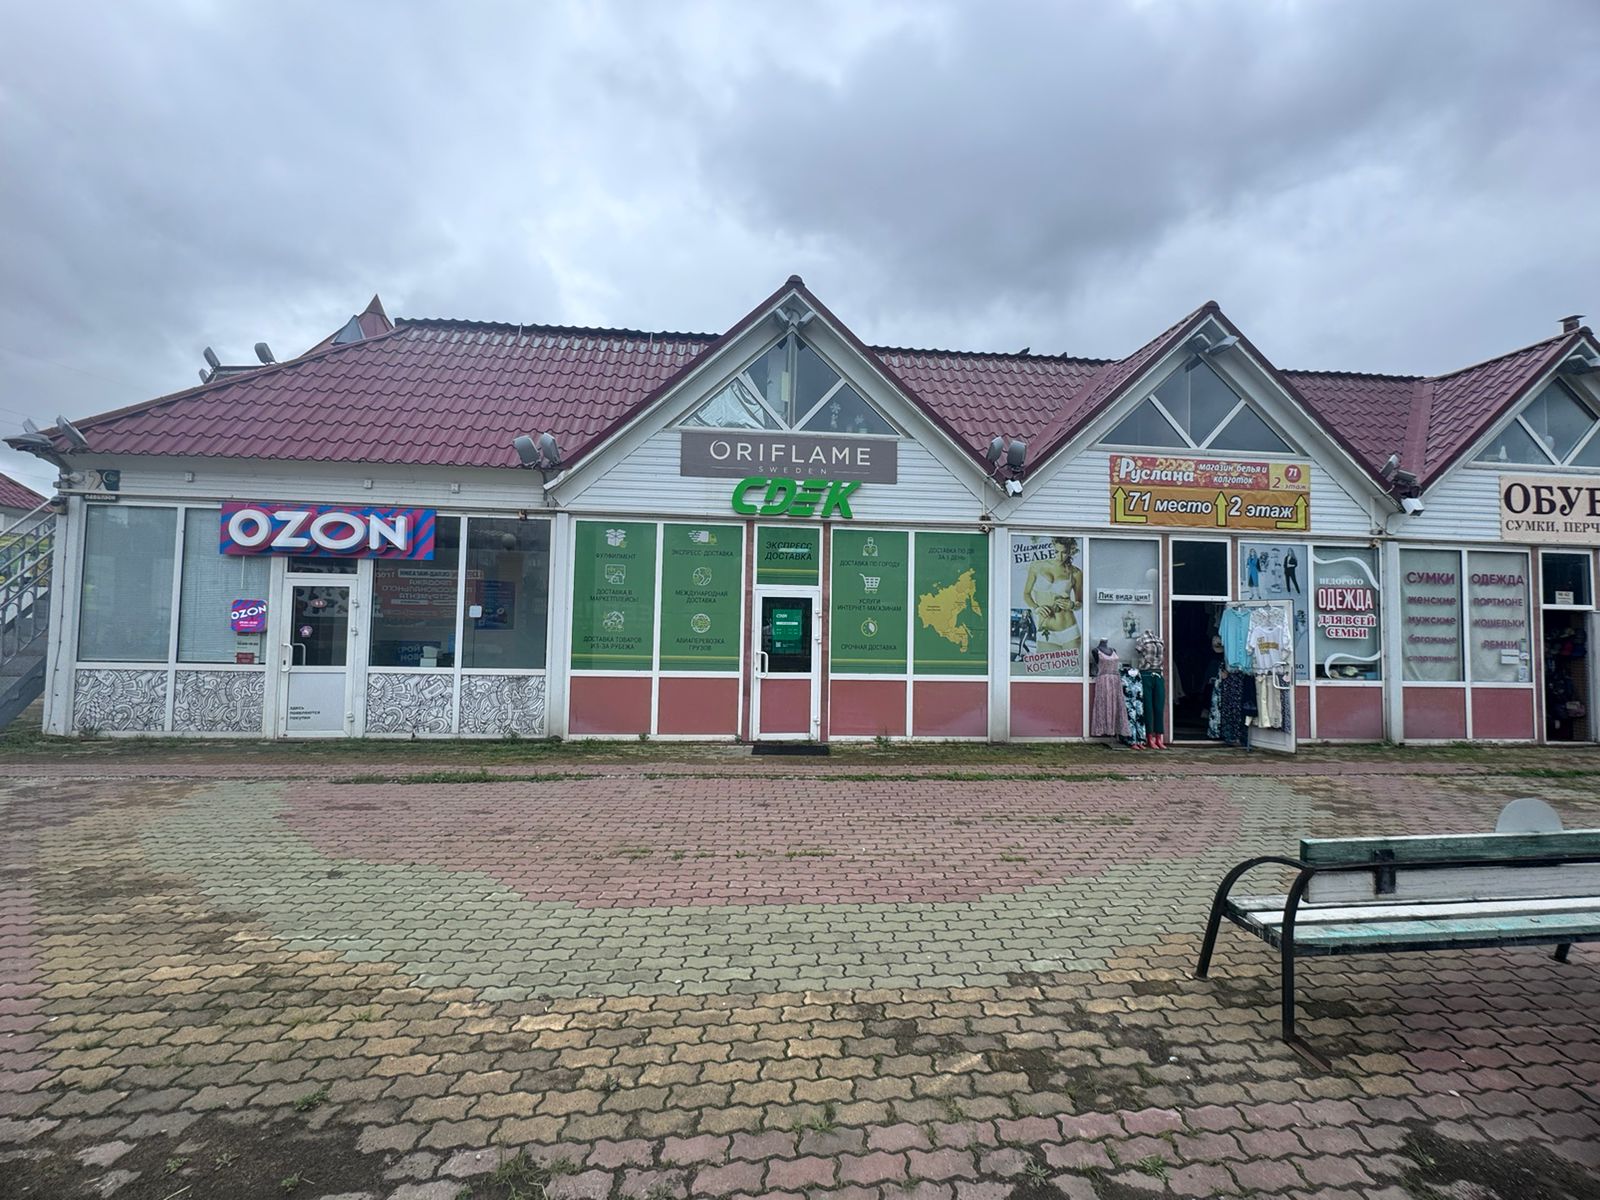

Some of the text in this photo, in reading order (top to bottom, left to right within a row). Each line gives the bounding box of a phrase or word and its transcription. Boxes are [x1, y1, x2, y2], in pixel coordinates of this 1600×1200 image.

[710, 439, 871, 466] ORIFLAME
[758, 466, 827, 475] SWEDEN
[1119, 457, 1195, 483] Руслана
[1198, 463, 1234, 472] магазин
[1236, 463, 1261, 474] белья
[1288, 468, 1298, 477] 71
[1213, 475, 1253, 485] колготок
[1272, 477, 1281, 489] 2
[731, 475, 863, 519] CDEK
[1128, 491, 1293, 519] 71 место 2 этаж
[228, 508, 408, 551] OZON
[1505, 519, 1560, 533] СУМКИ,
[765, 540, 813, 550] ЭКСПРЕСС
[1013, 543, 1052, 553] Нижнее
[764, 551, 813, 561] ДОСТАВКА
[1014, 549, 1056, 564] БЕЛЬЕ
[1319, 577, 1364, 585] НЕДОРОГО
[1406, 571, 1455, 585] СУМКИ
[1471, 573, 1524, 586] ОДЕЖДА
[1318, 588, 1374, 611] ОДЕЖДА
[1472, 597, 1523, 607] ПОРТМОНЕ
[231, 605, 267, 620] OZON
[1318, 614, 1377, 626] ДЛЯ ВСЕЙ
[1472, 618, 1525, 629] КОШЕЛЬКИ
[583, 635, 615, 643] ДОСТАВКА
[1326, 627, 1368, 639] СЕМЬИ
[1481, 639, 1518, 650] РЕМНИ
[1023, 649, 1079, 663] СПОРТИВНЫЕ
[1026, 657, 1080, 673] КОСТЮМЫ
